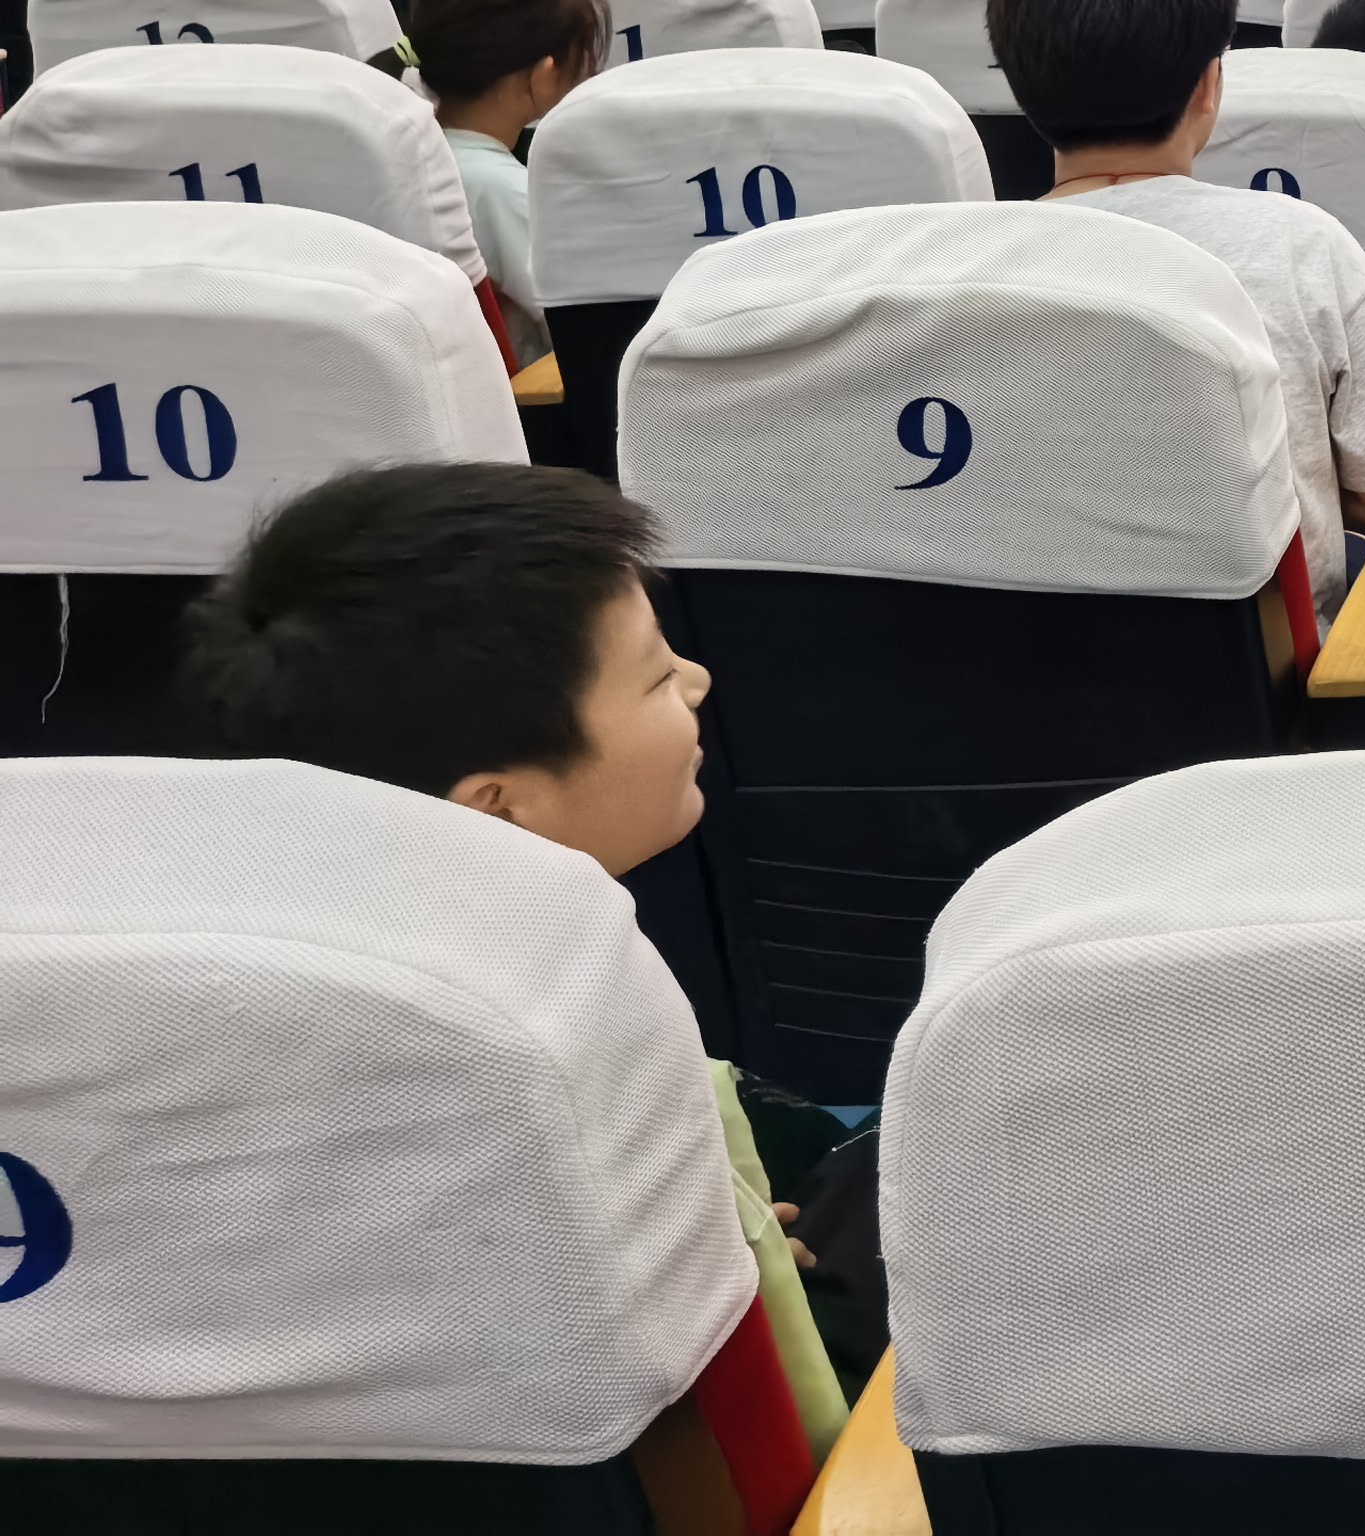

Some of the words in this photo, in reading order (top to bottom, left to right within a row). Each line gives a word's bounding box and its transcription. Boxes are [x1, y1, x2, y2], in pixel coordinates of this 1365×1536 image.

[685, 164, 797, 238] 10
[71, 382, 238, 482] 10
[893, 396, 974, 491] 9
